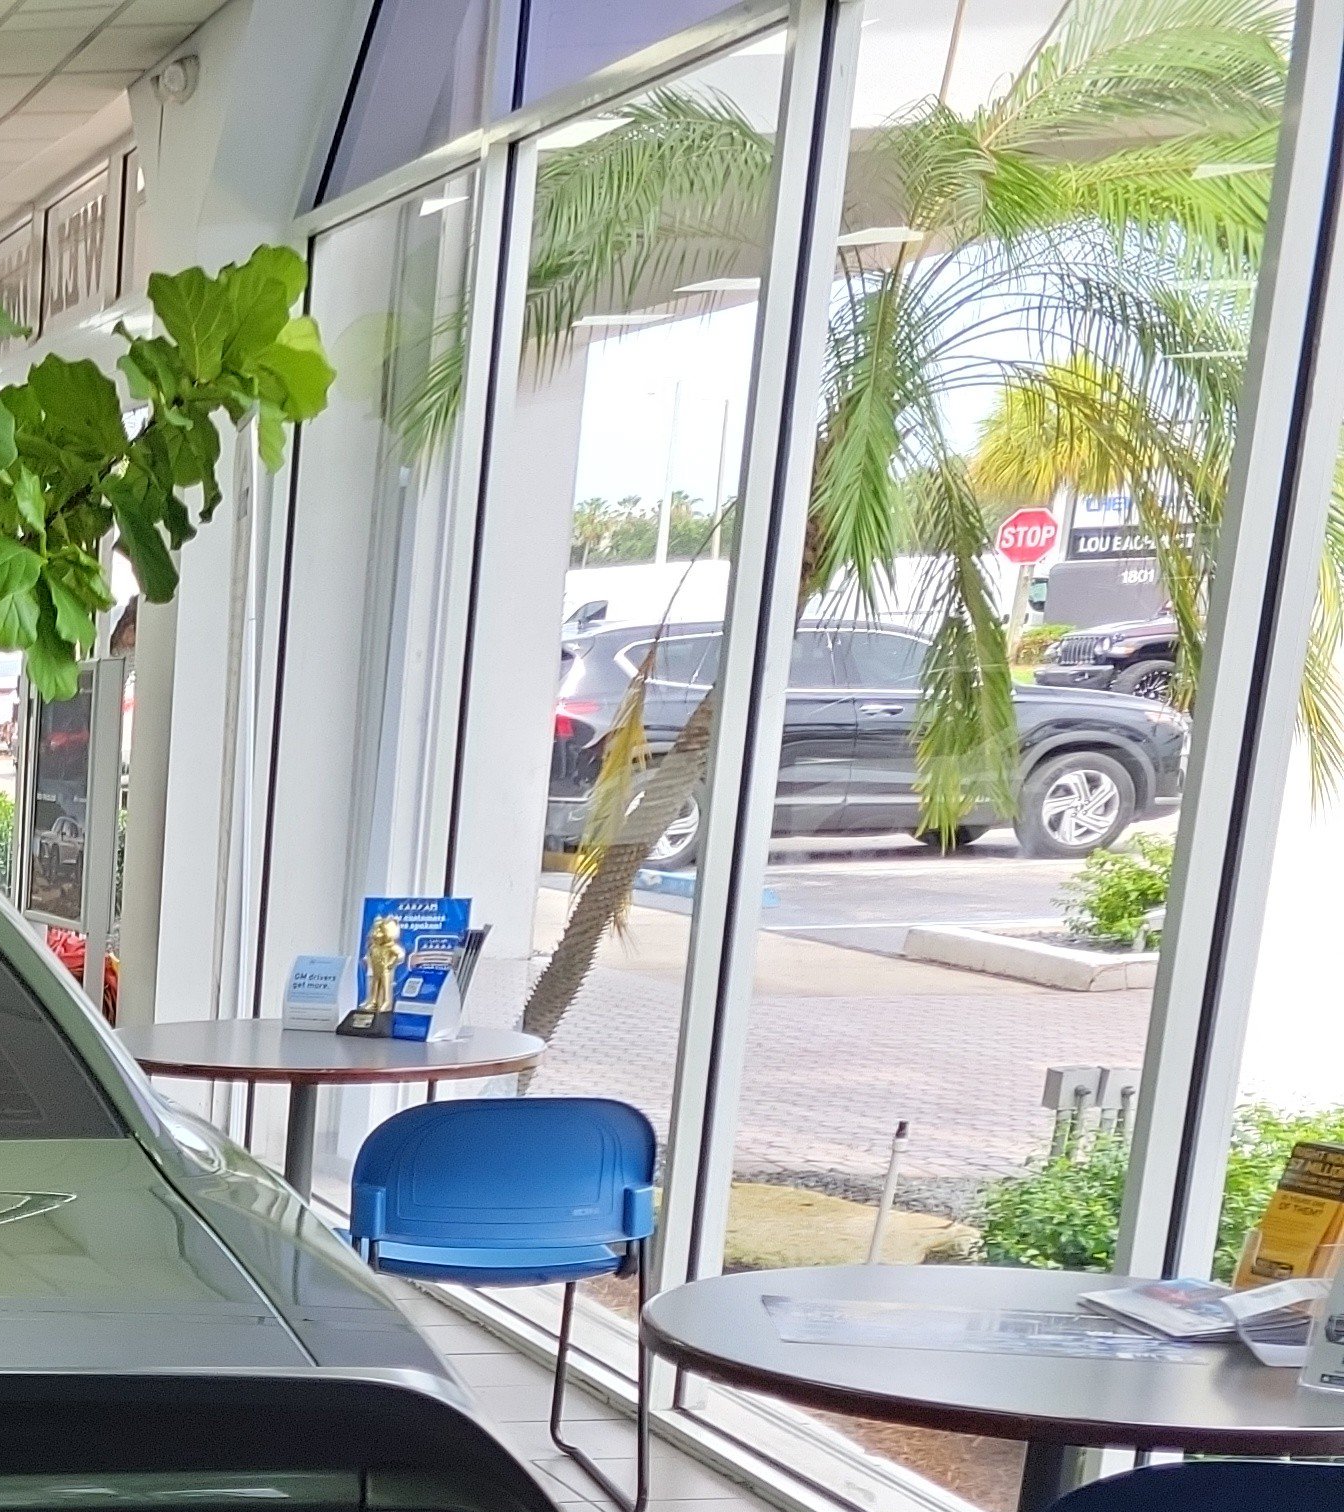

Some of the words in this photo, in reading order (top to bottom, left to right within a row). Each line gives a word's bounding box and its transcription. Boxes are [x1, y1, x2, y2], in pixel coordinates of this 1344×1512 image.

[1000, 525, 1057, 549] STOP
[1078, 535, 1111, 553] LOU
[1120, 569, 1155, 585] 1801
